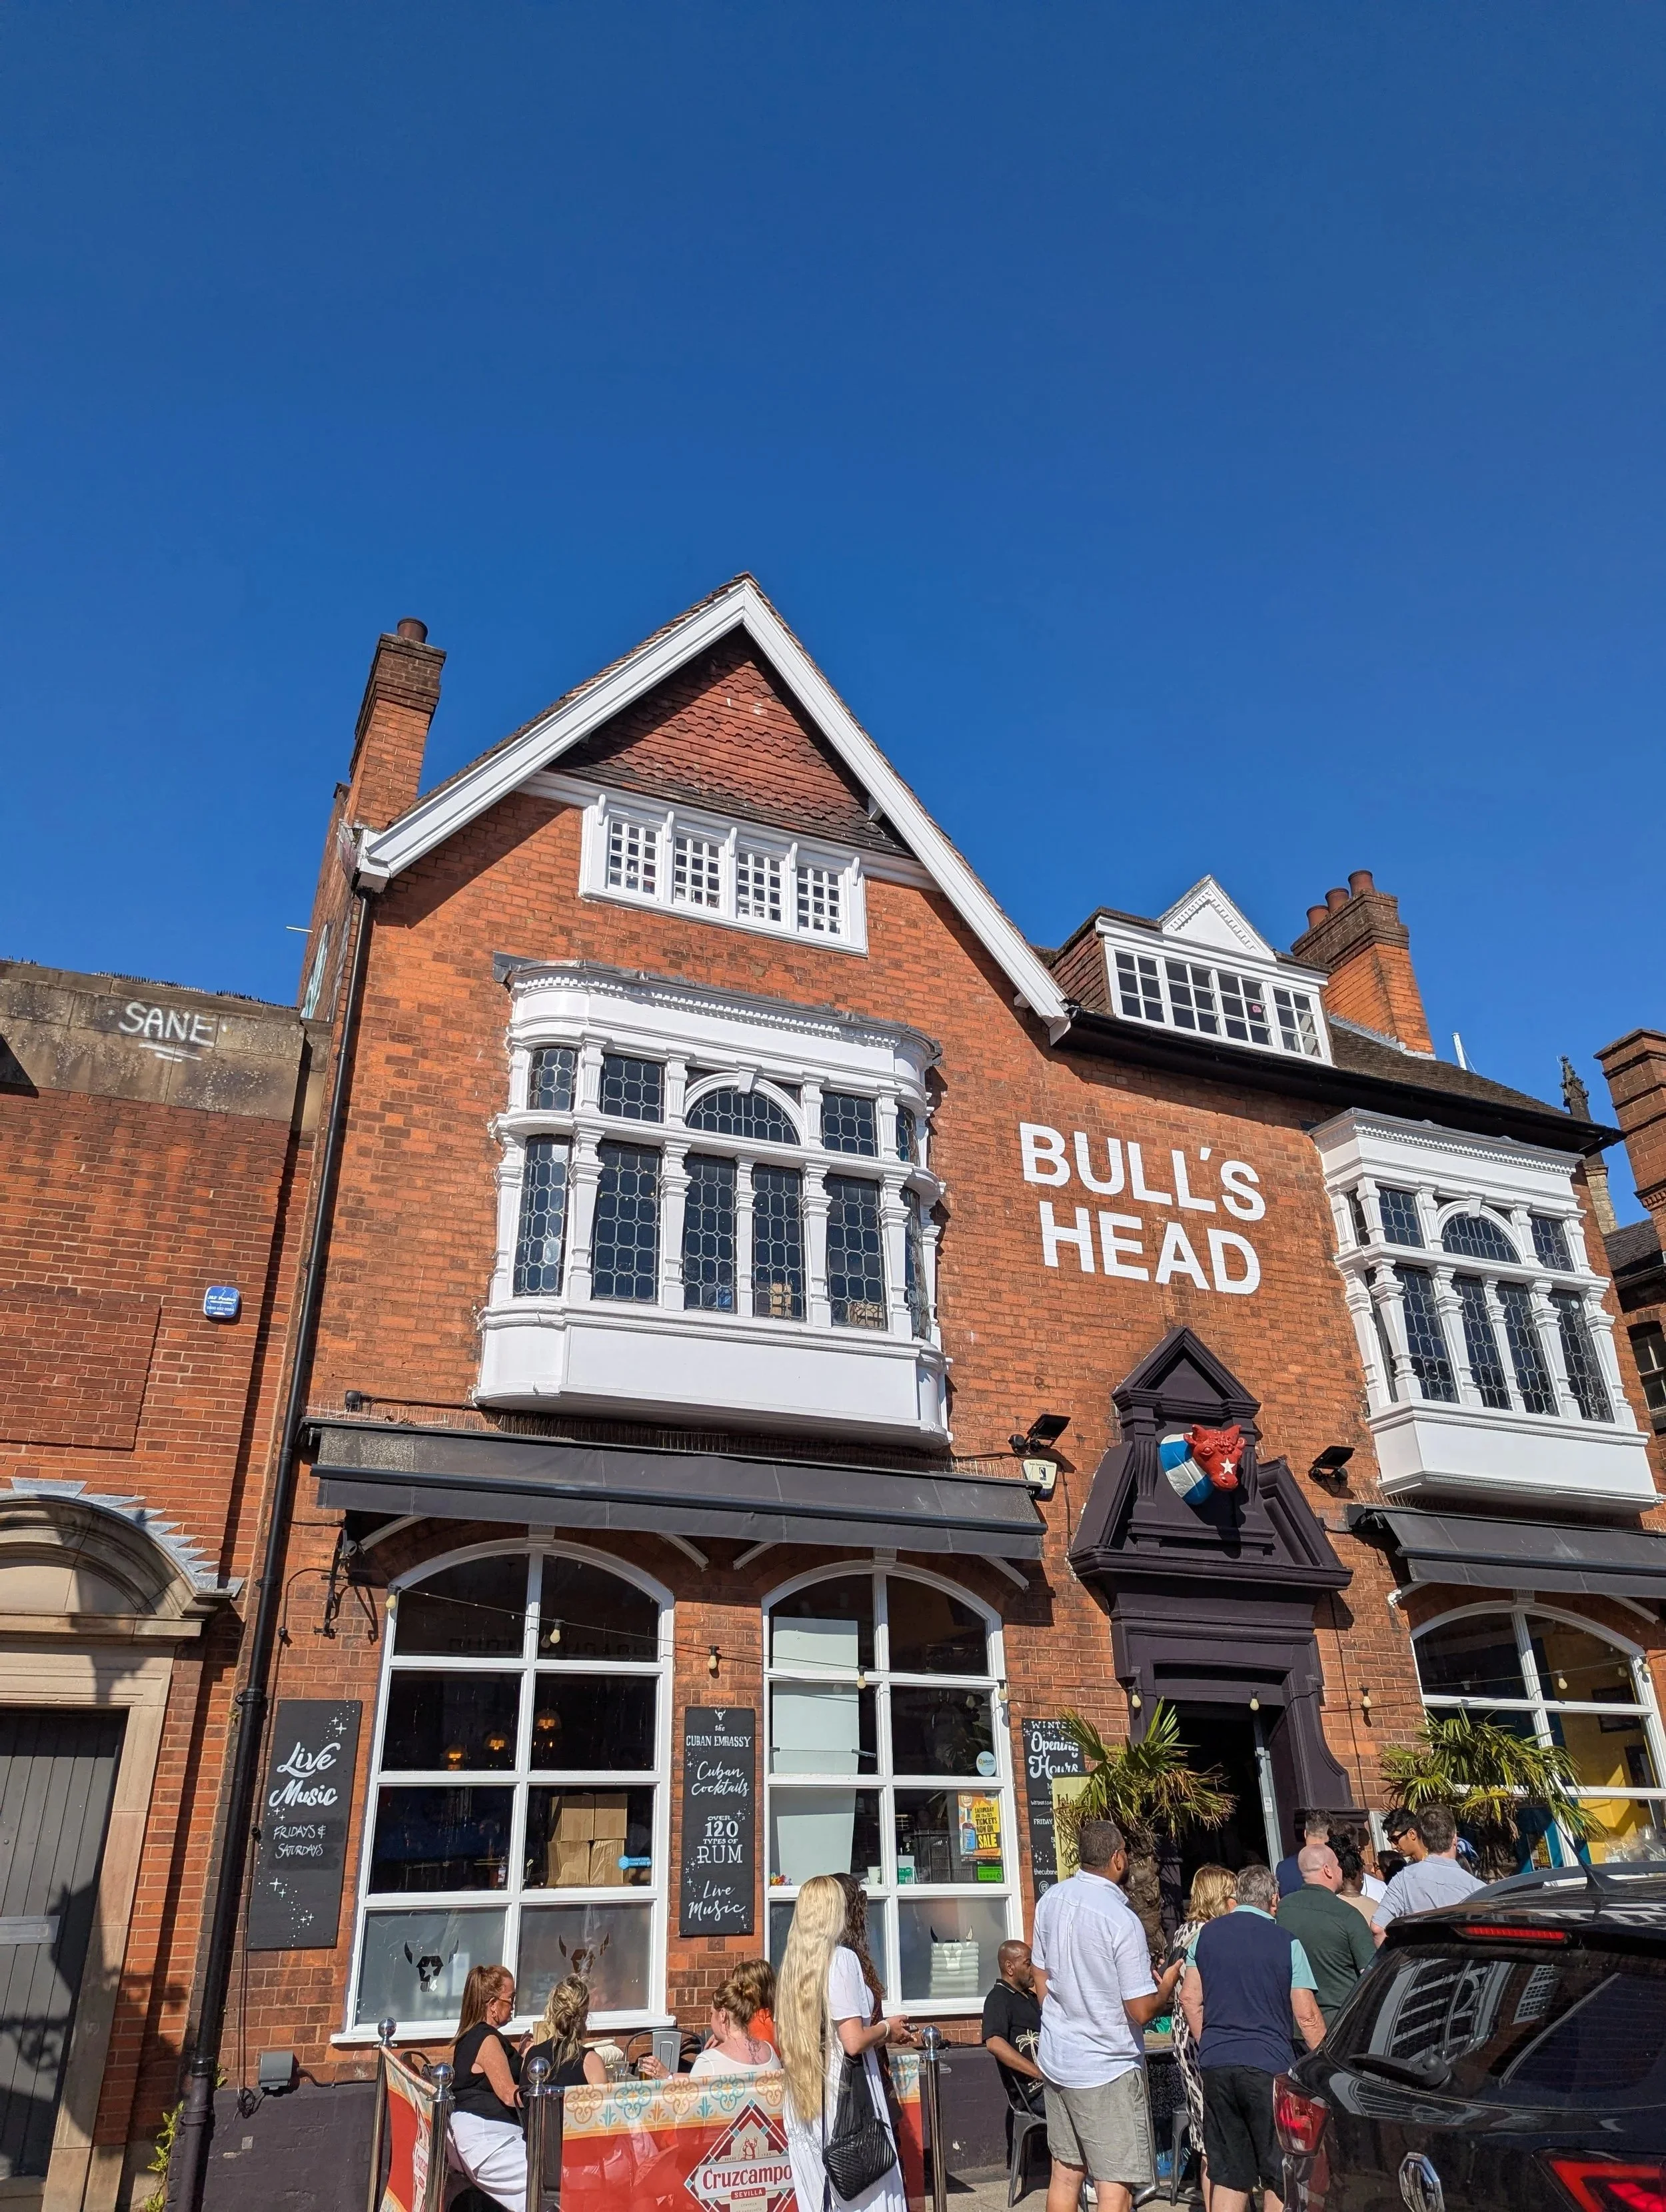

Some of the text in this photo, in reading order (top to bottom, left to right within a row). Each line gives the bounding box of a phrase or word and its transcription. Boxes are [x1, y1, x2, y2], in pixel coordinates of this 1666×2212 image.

[119, 1001, 216, 1048] SANE
[1019, 1122, 1266, 1221] BULL'S
[1039, 1201, 1261, 1295] HEAD
[686, 1735, 752, 1748] CUBAN EMBASSY
[1031, 1731, 1079, 1758] Opening
[277, 1741, 341, 1778] Live
[696, 1760, 744, 1781] Cuban
[269, 1778, 339, 1807] Music
[704, 1820, 739, 1838] 120
[975, 1817, 998, 1826] TICKETS
[273, 1824, 317, 1841] FRIDAYS
[978, 1834, 998, 1849] SALE
[275, 1843, 324, 1860] SATURDAYS
[697, 1844, 744, 1865] RUM
[703, 1880, 736, 1899] Live
[688, 1900, 746, 1922] Music
[702, 2165, 792, 2190] Cruzcampo
[734, 2189, 763, 2199] SEVILLA
